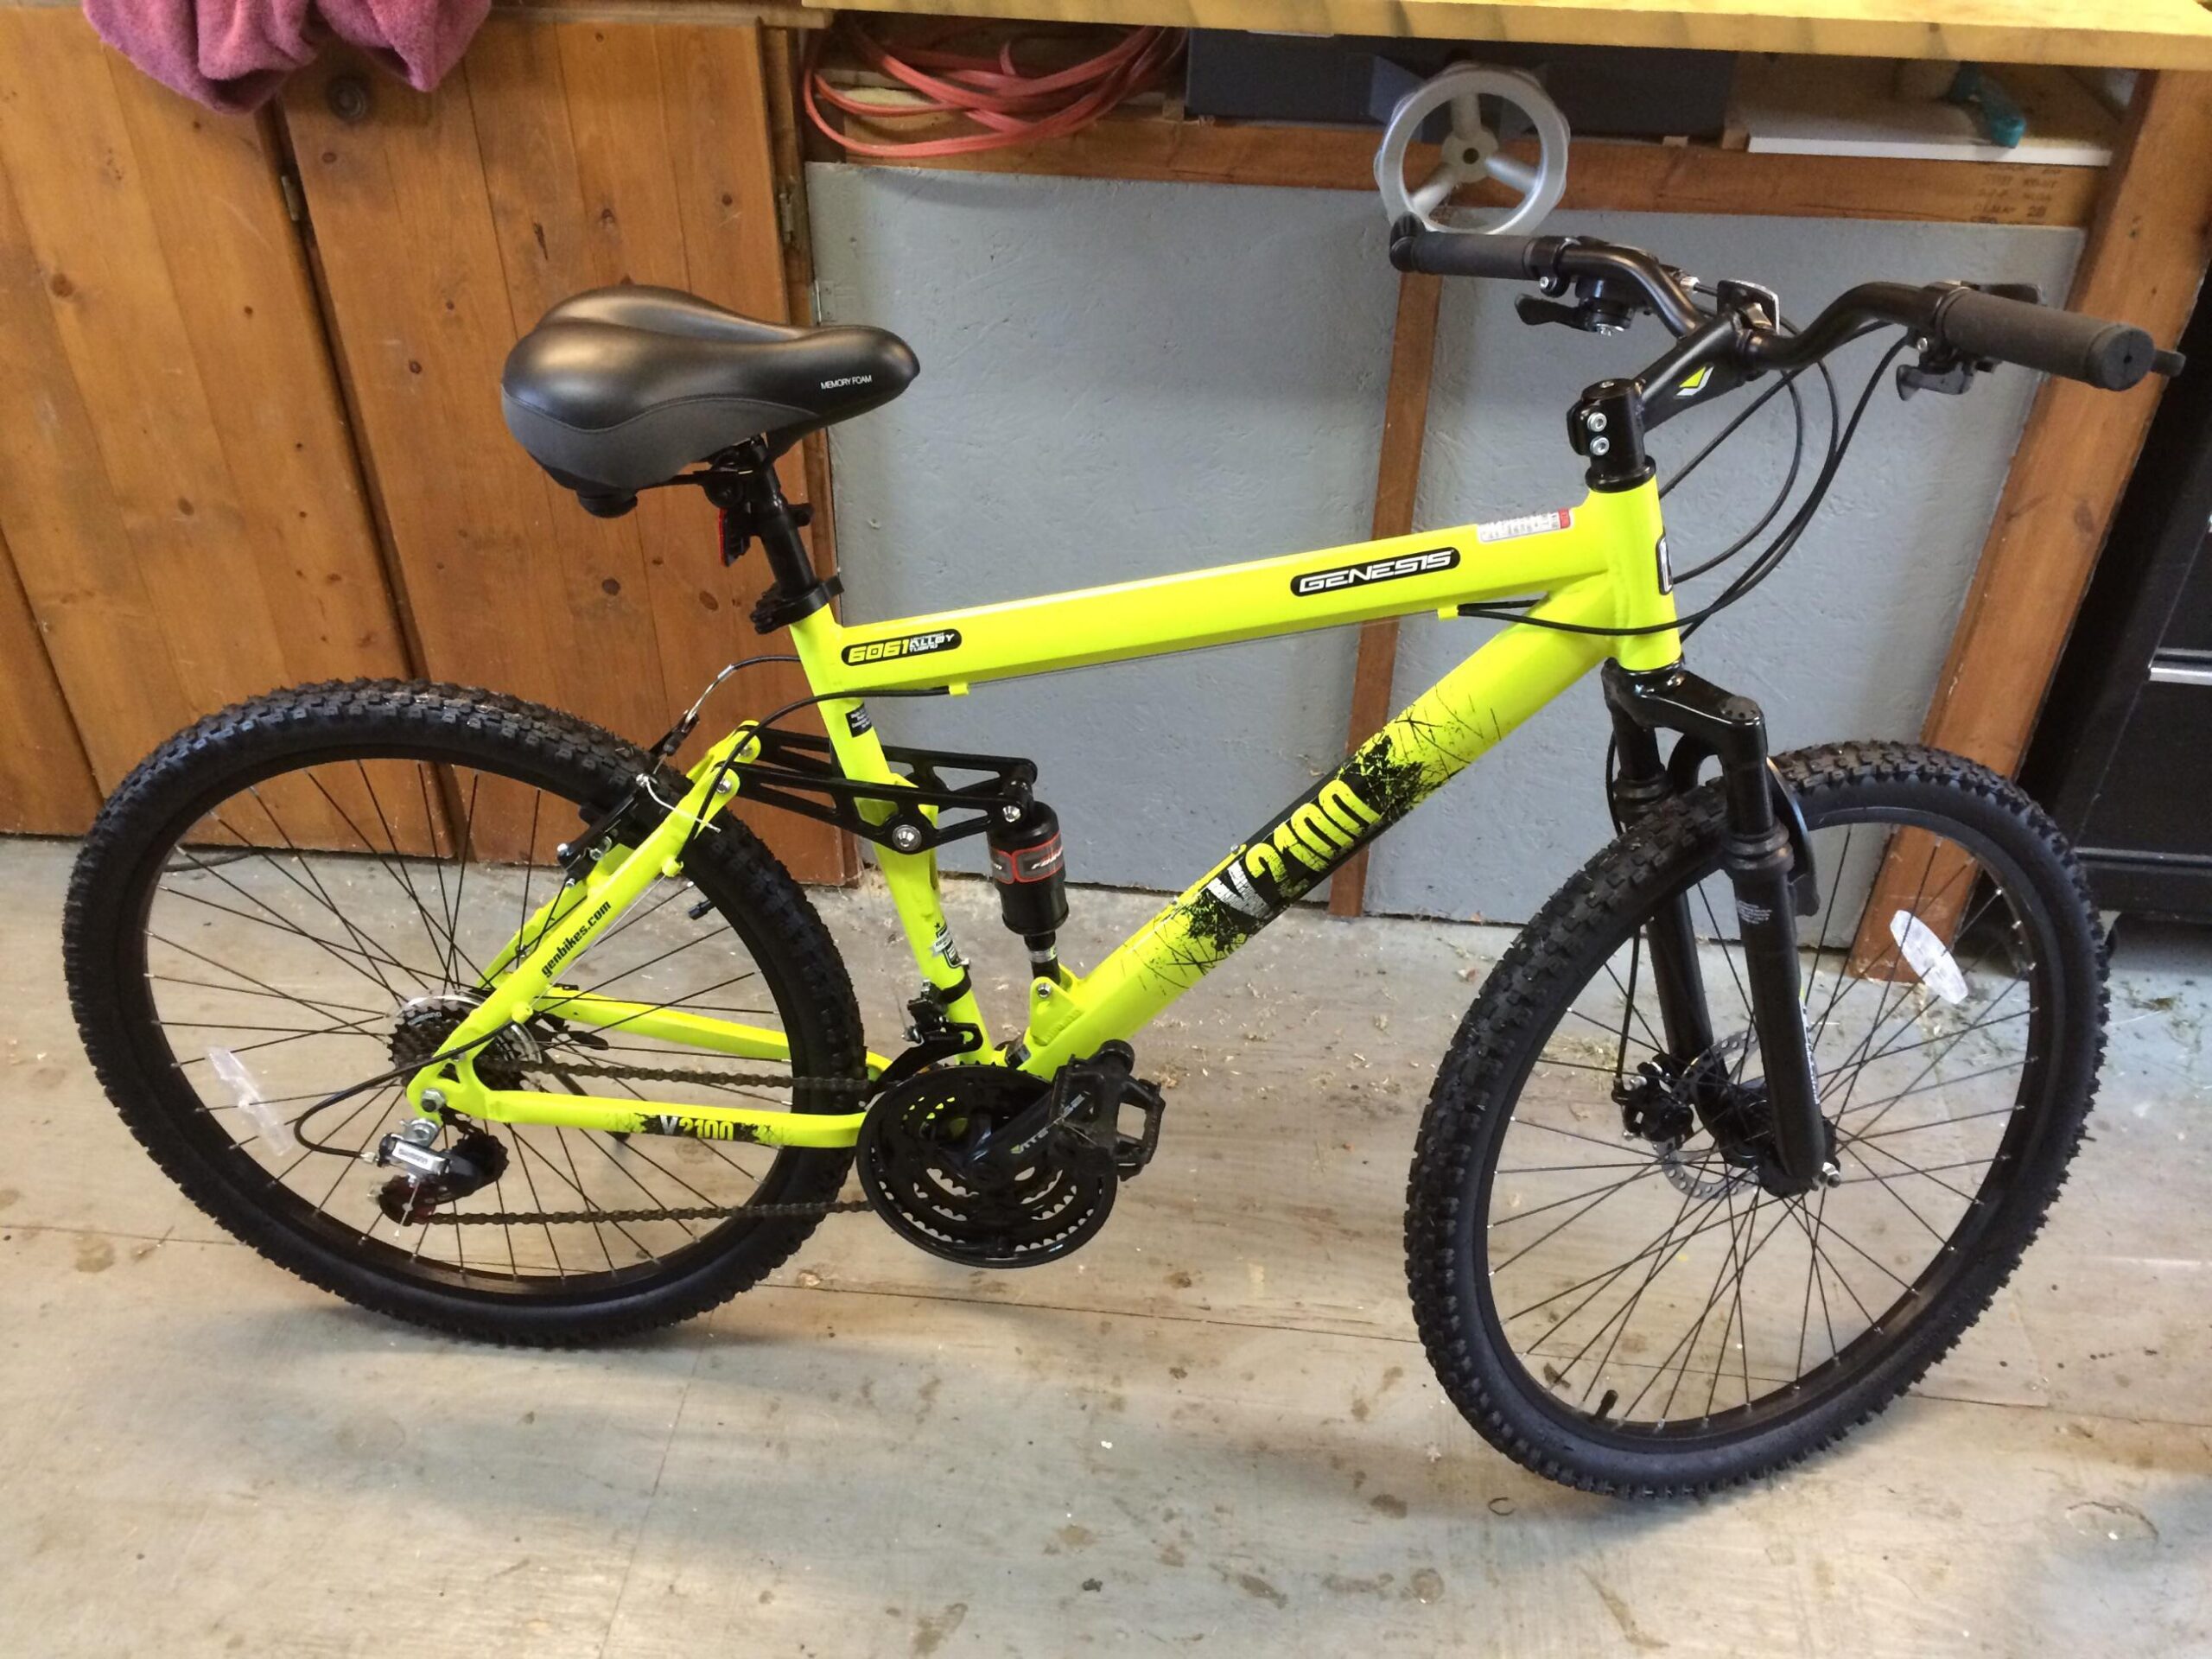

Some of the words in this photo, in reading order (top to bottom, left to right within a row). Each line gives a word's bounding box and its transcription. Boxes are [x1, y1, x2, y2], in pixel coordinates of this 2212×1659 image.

[820, 378, 851, 390] MEMORY
[851, 375, 872, 385] FOAM
[1299, 550, 1452, 593] GENESIS
[848, 639, 910, 664] 6061
[910, 633, 956, 649] ALLOY
[1206, 779, 1381, 918] V2100
[541, 901, 611, 978] genbikes.com
[659, 1114, 734, 1141] V2100
